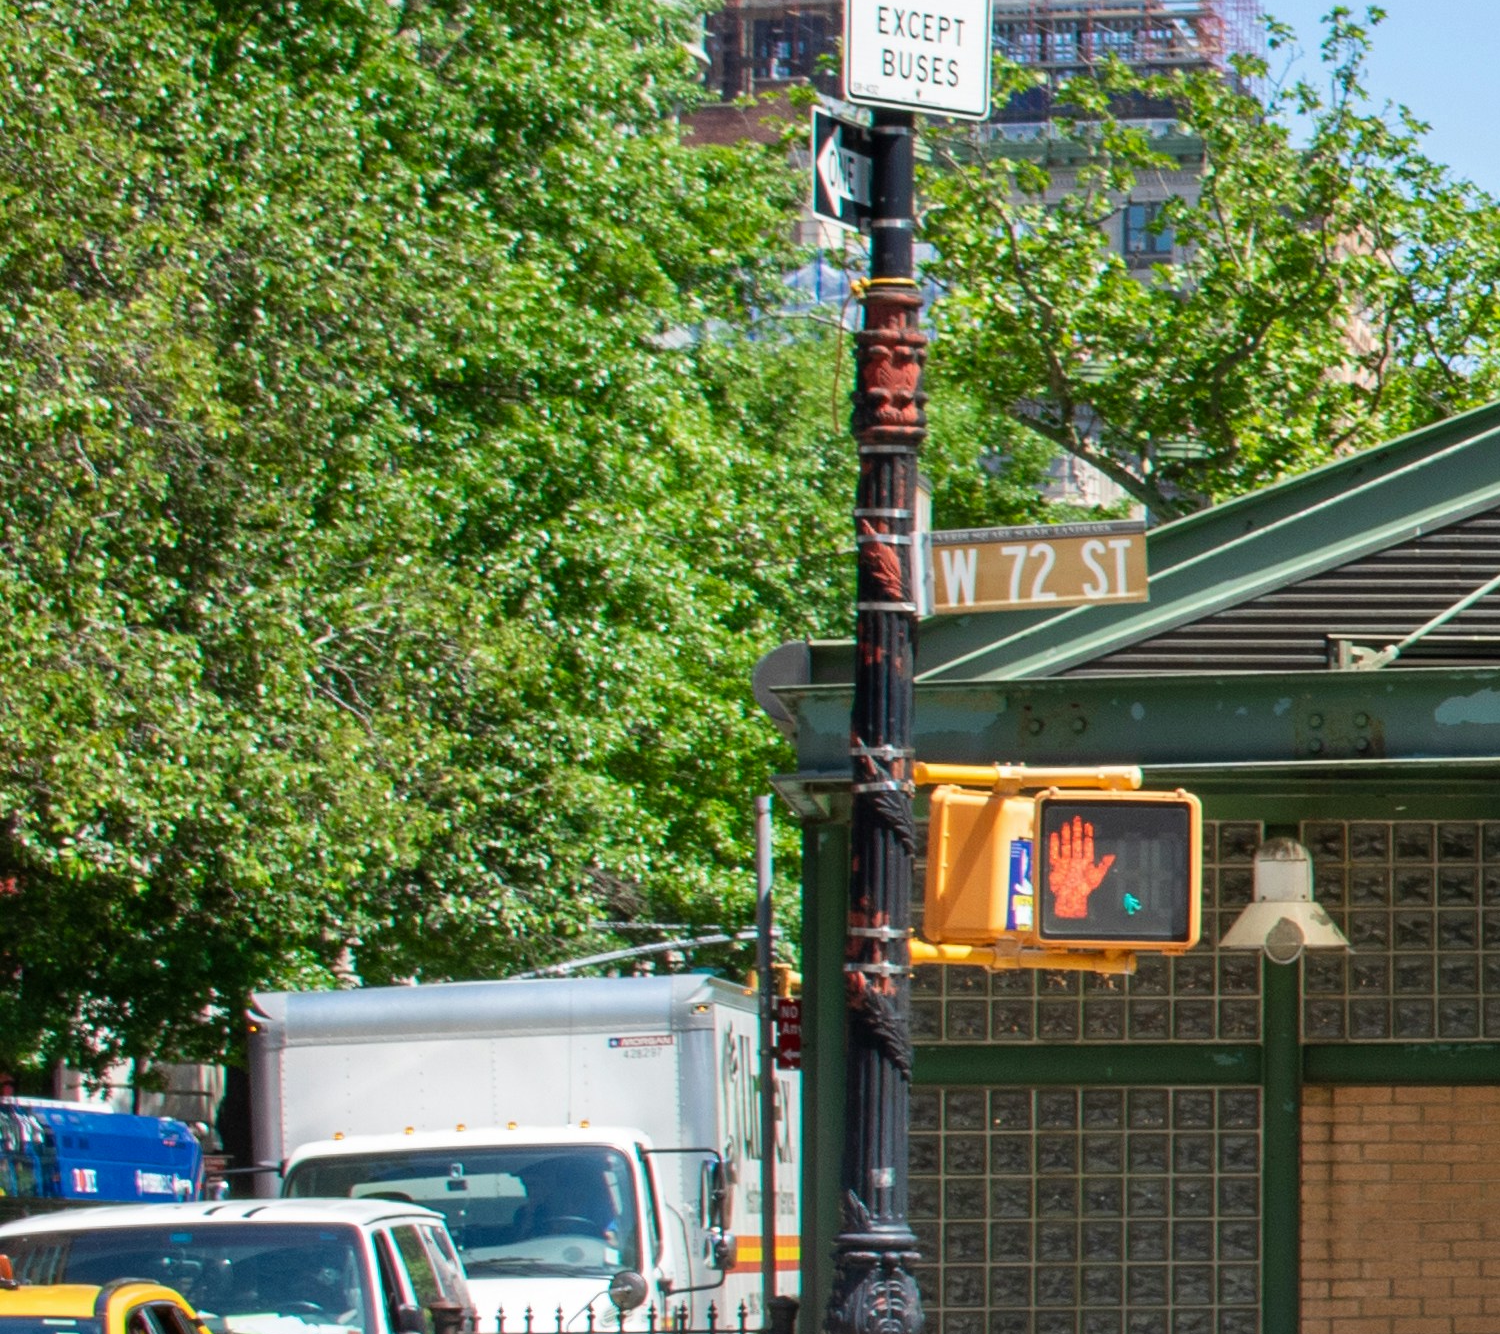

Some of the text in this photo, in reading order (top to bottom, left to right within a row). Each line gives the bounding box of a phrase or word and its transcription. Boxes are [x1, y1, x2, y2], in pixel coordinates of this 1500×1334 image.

[877, 5, 966, 47] EXCEPT
[882, 48, 960, 88] BUSES
[940, 538, 1133, 608] W 72 ST
[621, 1036, 673, 1047] MORGAN
